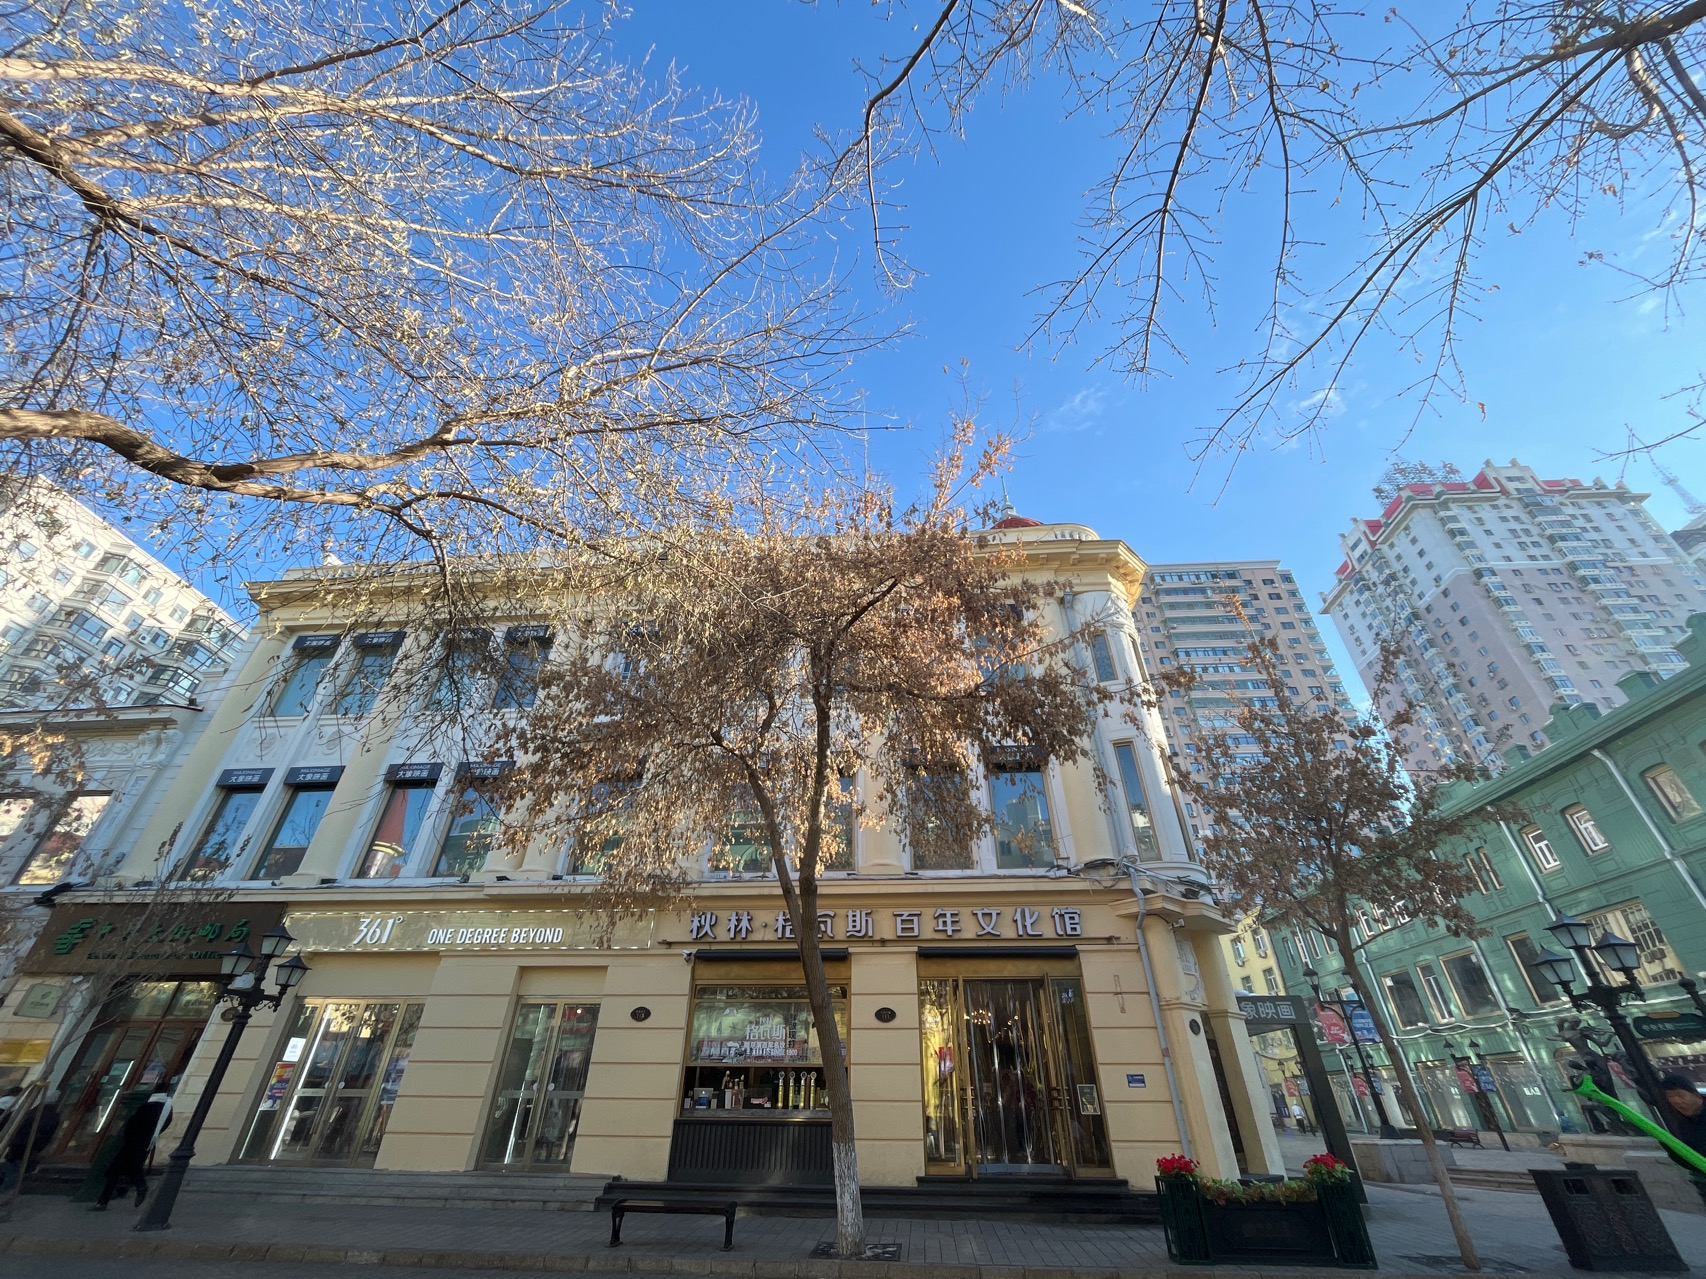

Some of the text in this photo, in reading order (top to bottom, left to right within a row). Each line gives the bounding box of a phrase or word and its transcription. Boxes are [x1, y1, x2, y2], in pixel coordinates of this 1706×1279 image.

[228, 775, 261, 783] 大象映画
[296, 773, 330, 781] 大象映画
[427, 928, 455, 944] ONE
[456, 928, 509, 944] DEGREE
[511, 927, 564, 943] BEYOND
